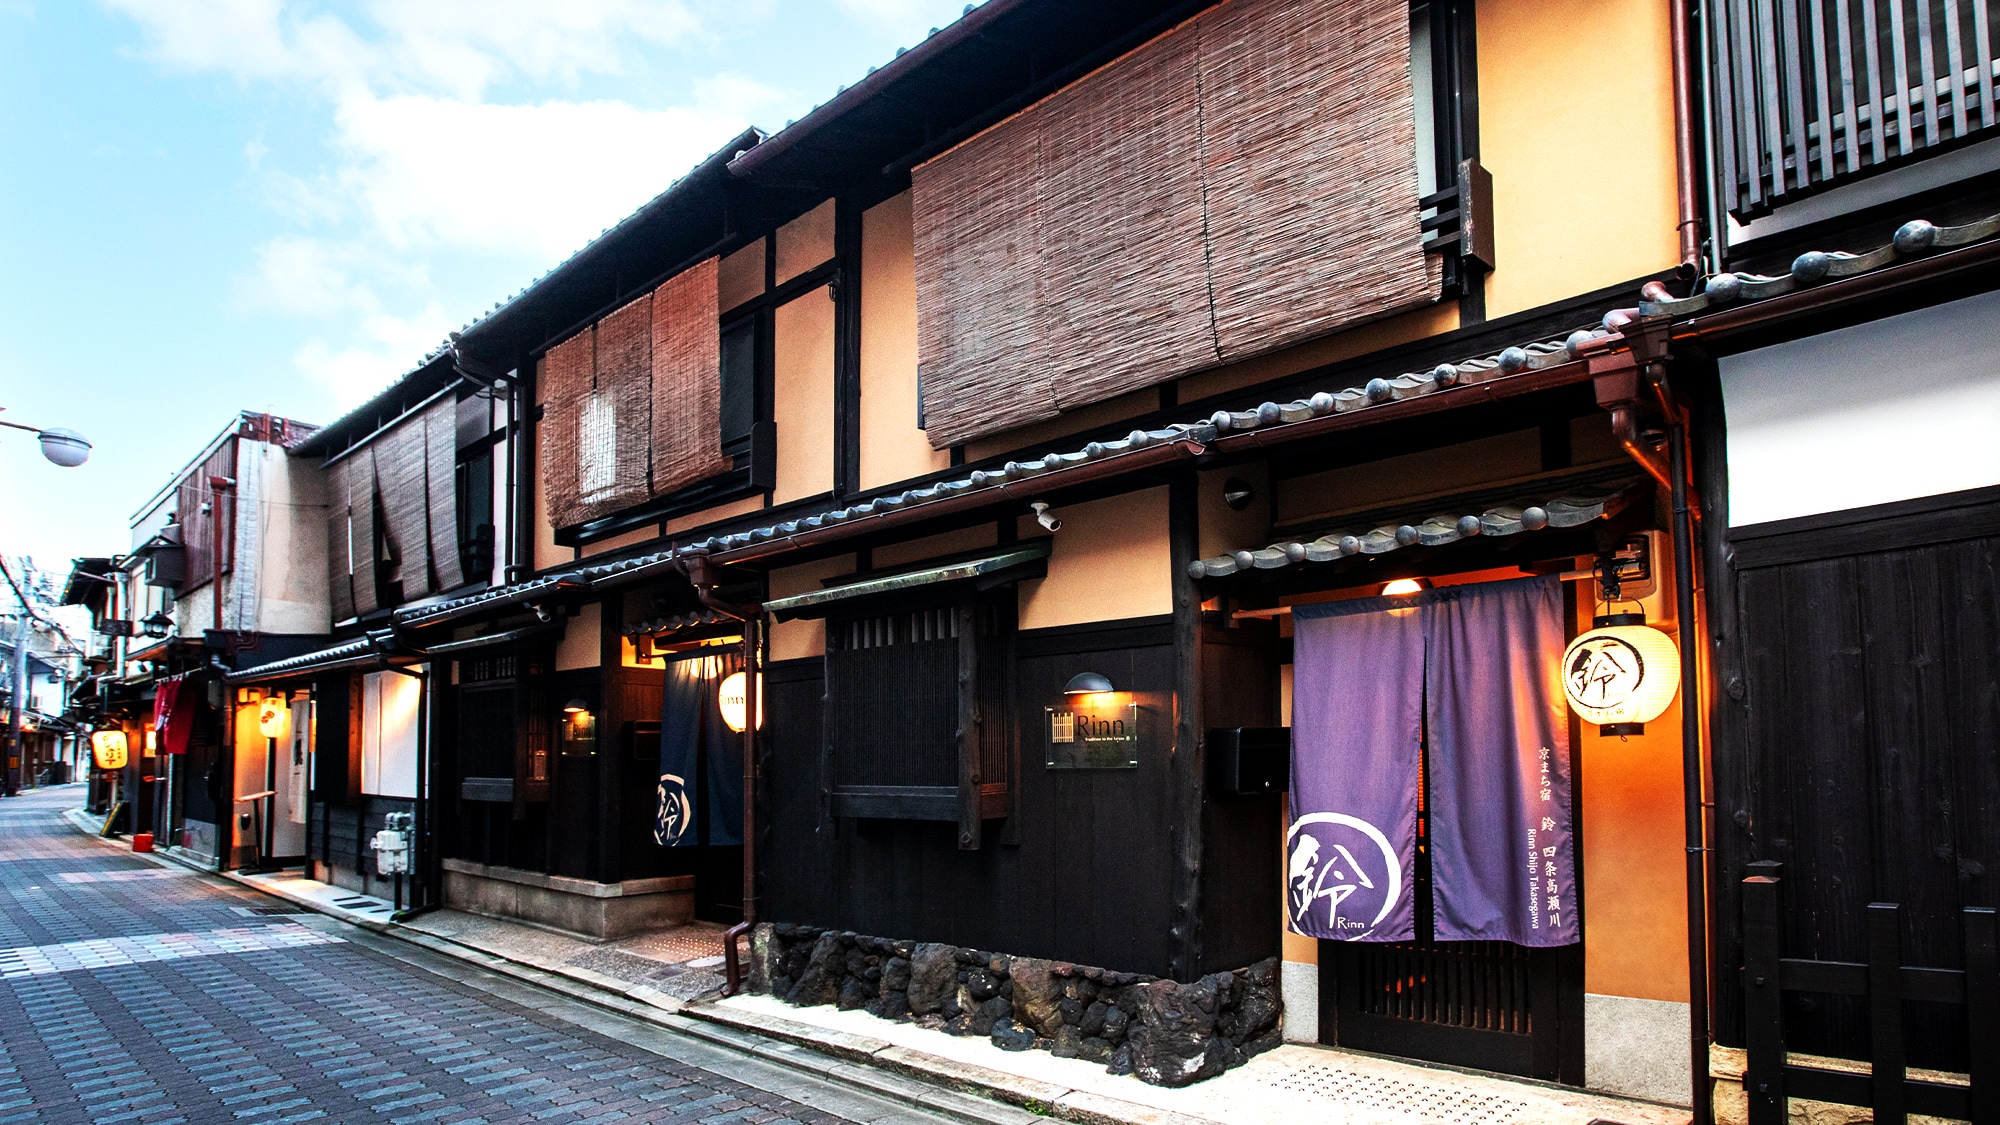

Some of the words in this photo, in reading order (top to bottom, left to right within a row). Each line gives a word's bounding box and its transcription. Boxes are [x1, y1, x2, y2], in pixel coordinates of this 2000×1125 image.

[1077, 715, 1125, 736] Rinn
[1539, 747, 1551, 801] 京まち宿
[1541, 817, 1556, 831] 鈴
[1527, 828, 1537, 850] Rinn
[1527, 850, 1538, 874] Shijo
[1289, 833, 1375, 930] 鈴
[1543, 846, 1561, 928] 四条高瀬川
[1528, 876, 1539, 929] Takasegawa
[1337, 916, 1365, 930] Rinn
